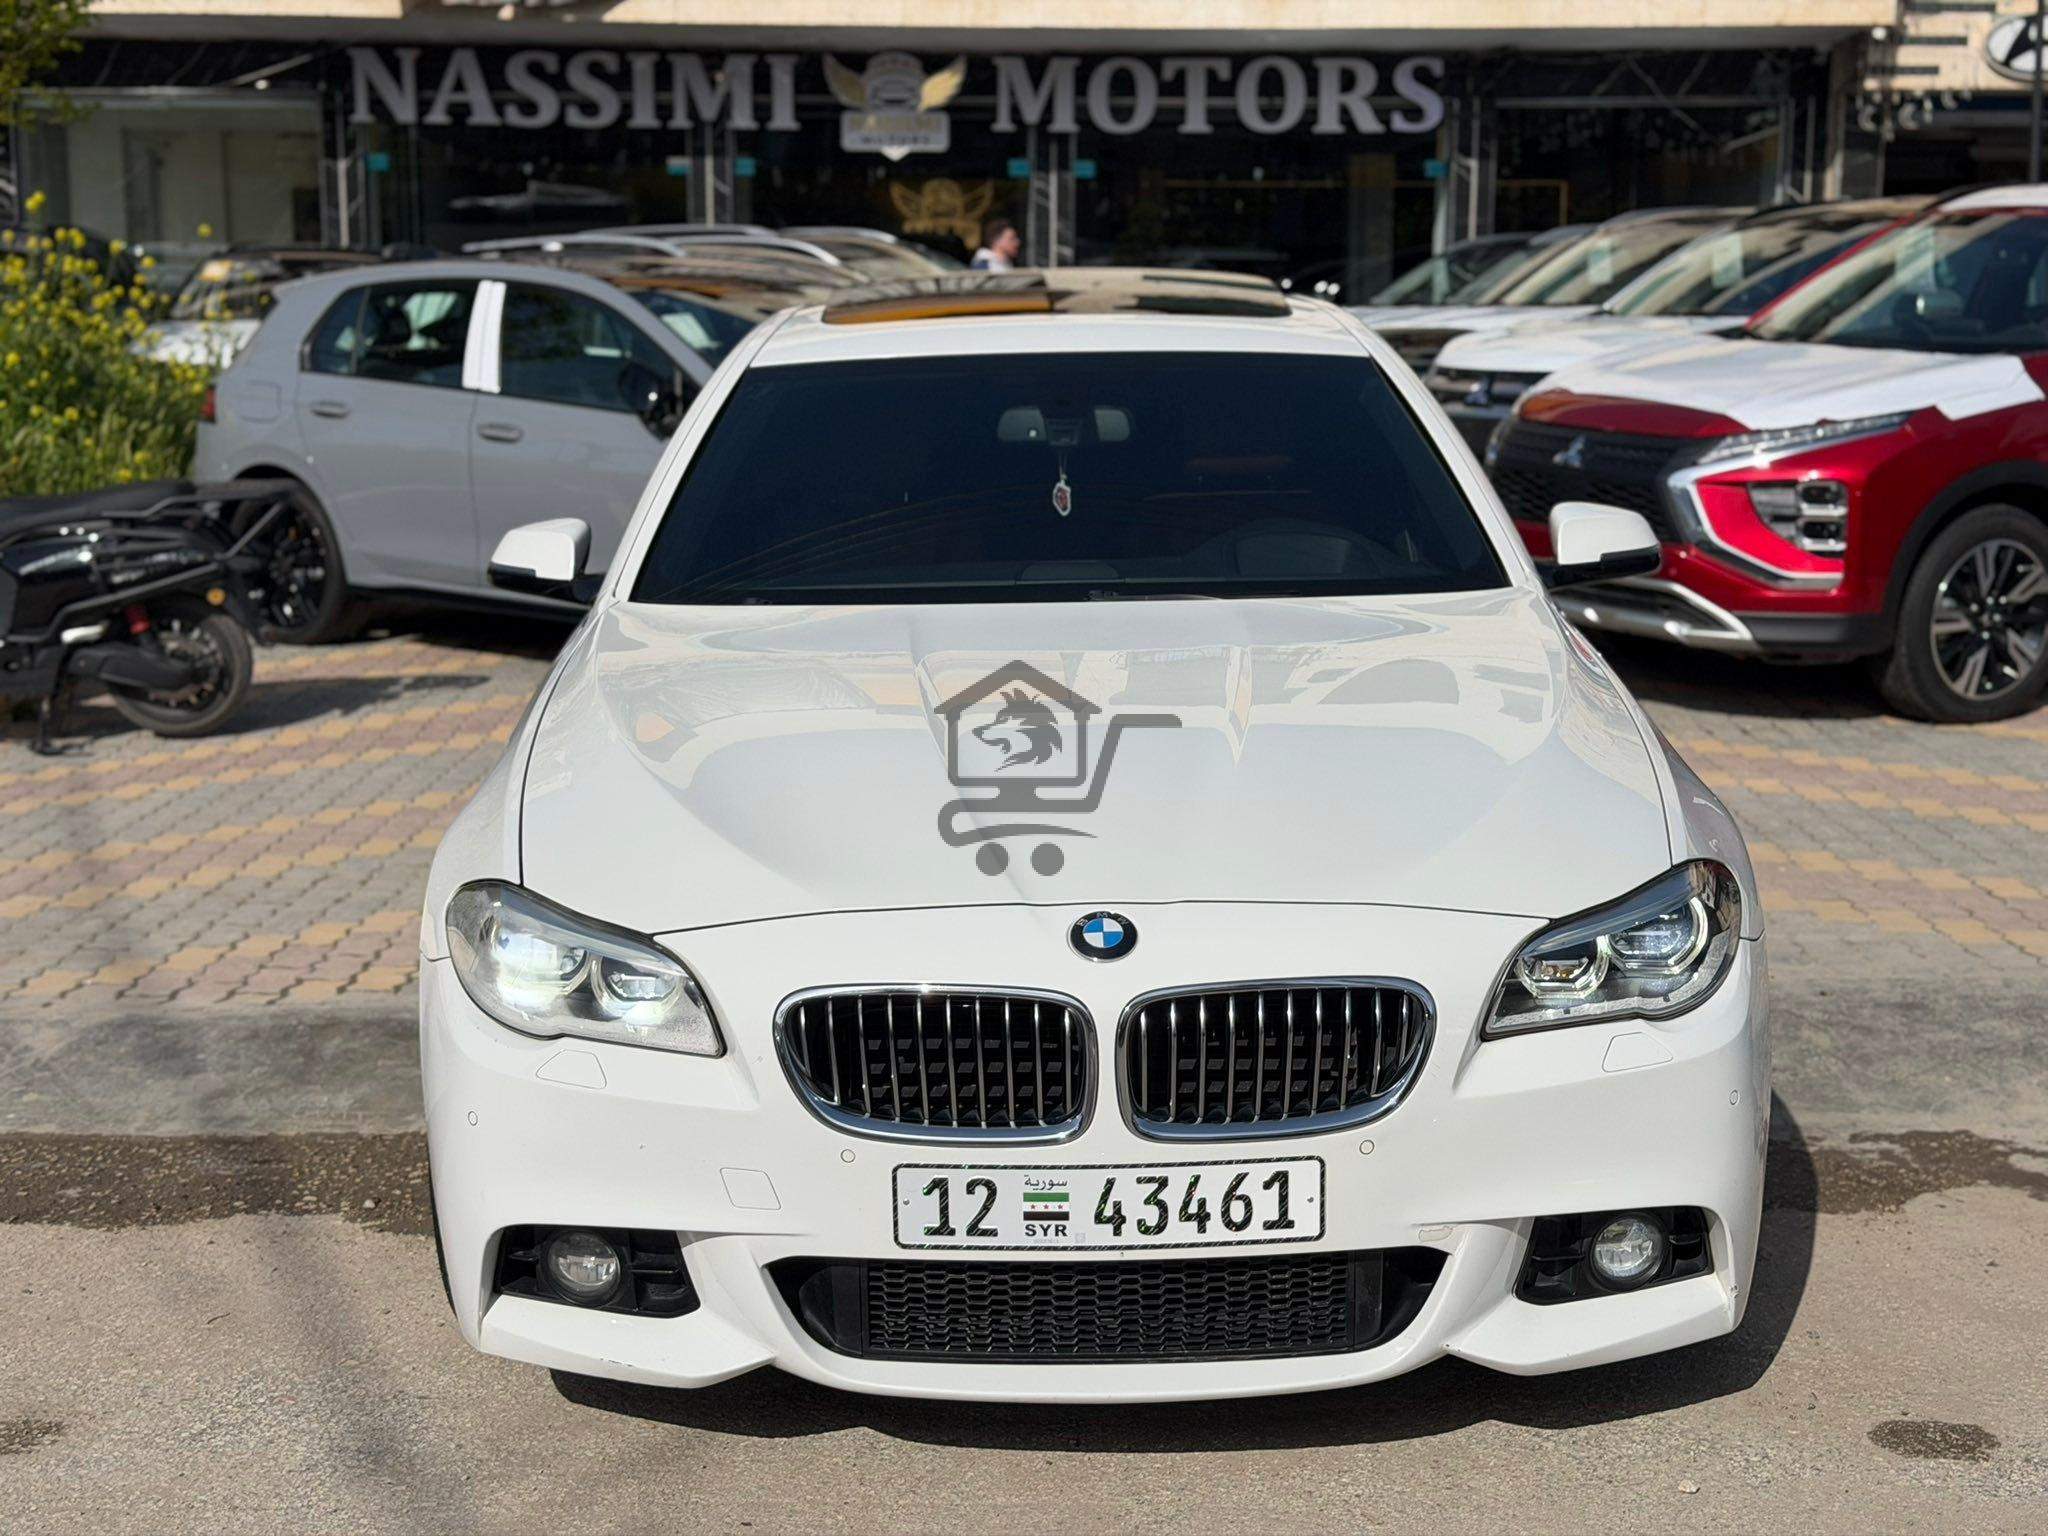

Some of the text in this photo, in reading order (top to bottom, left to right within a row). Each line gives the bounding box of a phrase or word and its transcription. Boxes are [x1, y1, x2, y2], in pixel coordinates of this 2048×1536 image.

[346, 47, 1447, 135] NASSIMI MOTORS
[921, 1169, 1296, 1237] 12 43461
[1023, 1174, 1069, 1191] سورية
[1024, 1223, 1069, 1238] SYR
